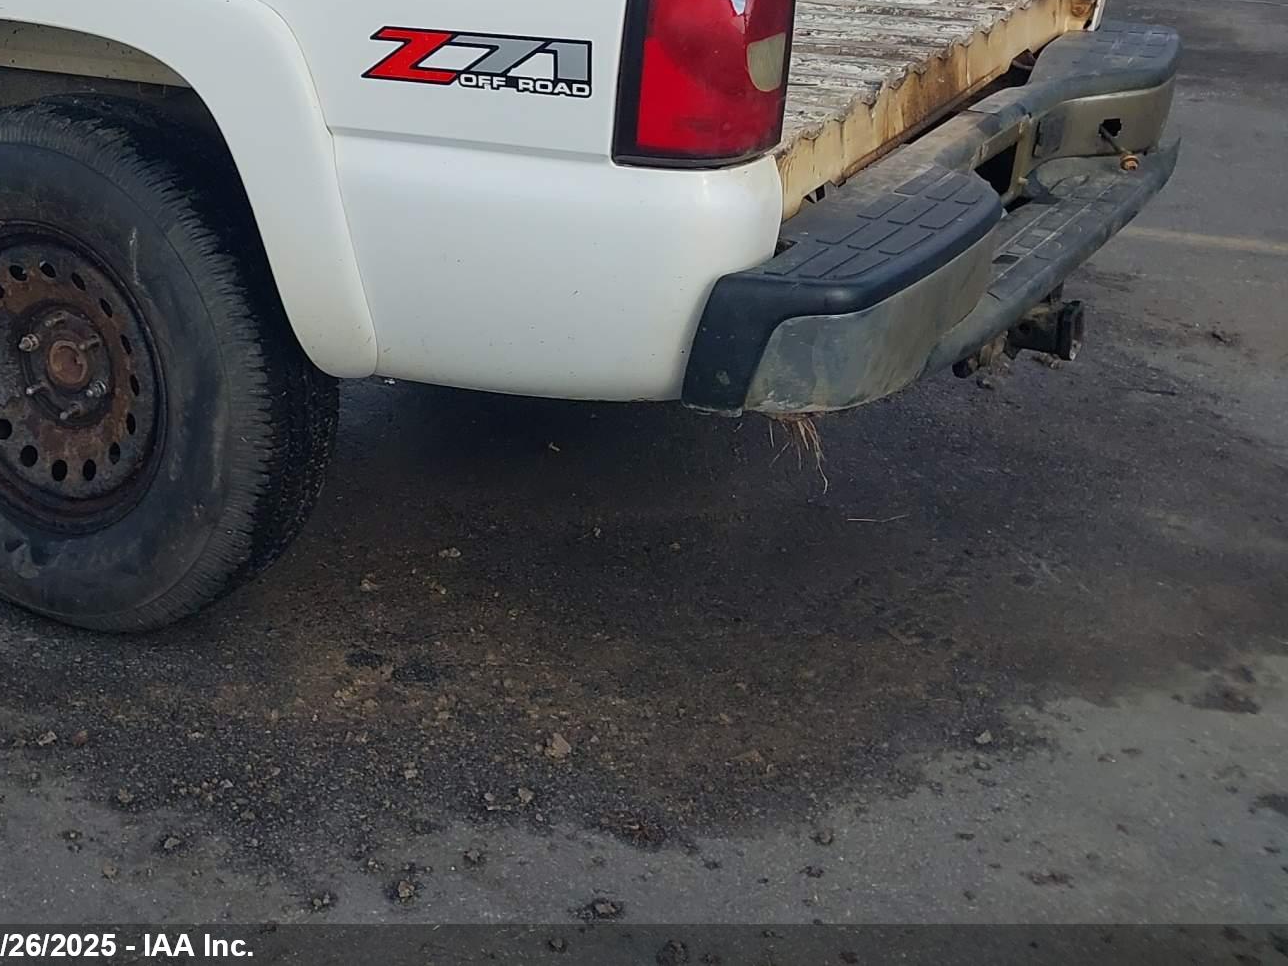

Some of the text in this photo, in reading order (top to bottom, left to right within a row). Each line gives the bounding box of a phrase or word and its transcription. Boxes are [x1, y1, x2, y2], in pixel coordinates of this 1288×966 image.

[362, 26, 592, 85] Z71
[459, 73, 591, 97] OFF ROAD
